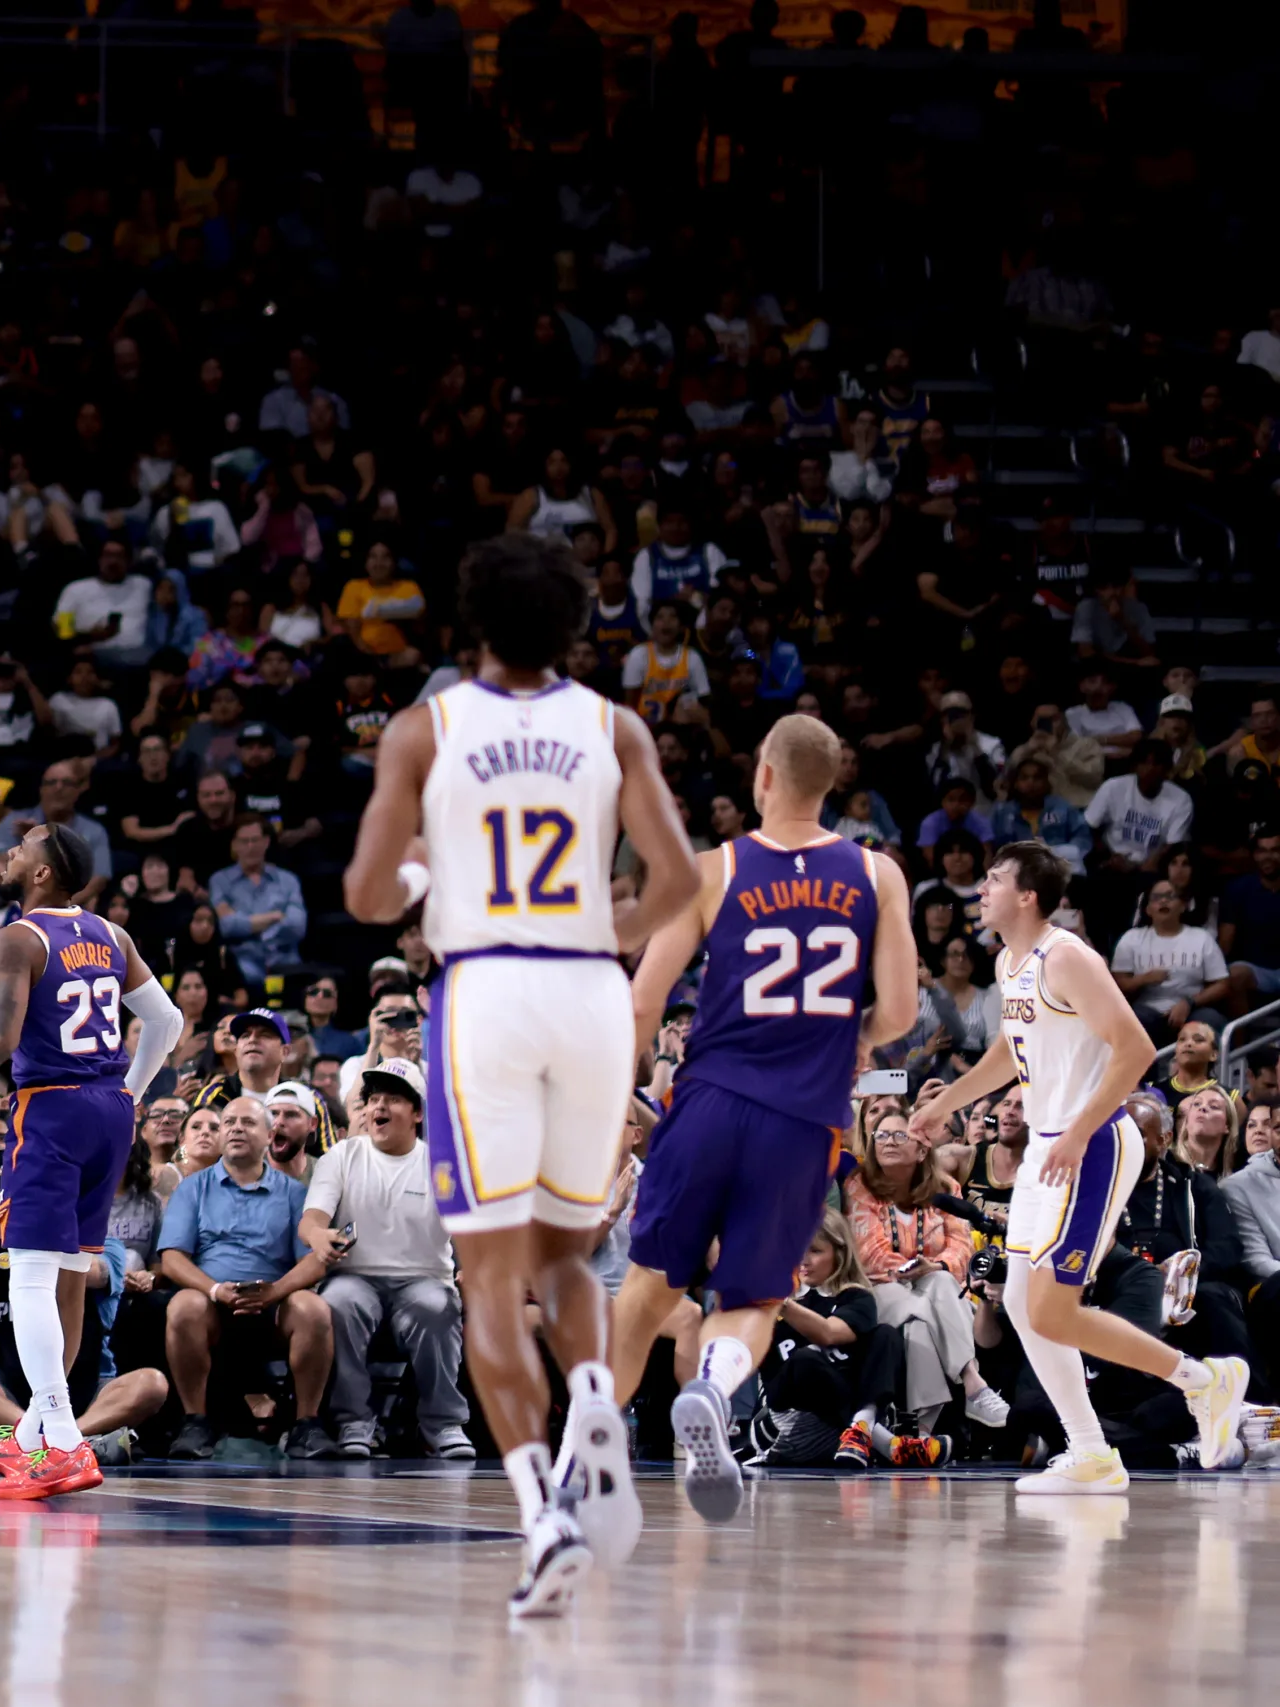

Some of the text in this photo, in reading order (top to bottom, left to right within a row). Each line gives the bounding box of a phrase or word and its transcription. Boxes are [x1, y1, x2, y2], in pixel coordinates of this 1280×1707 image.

[465, 737, 587, 784] CHRISTIE
[482, 804, 582, 916] 12
[737, 878, 862, 920] PLUMLEE
[58, 941, 113, 974] MORRIS
[743, 924, 861, 1017] 22
[56, 975, 122, 1055] 23
